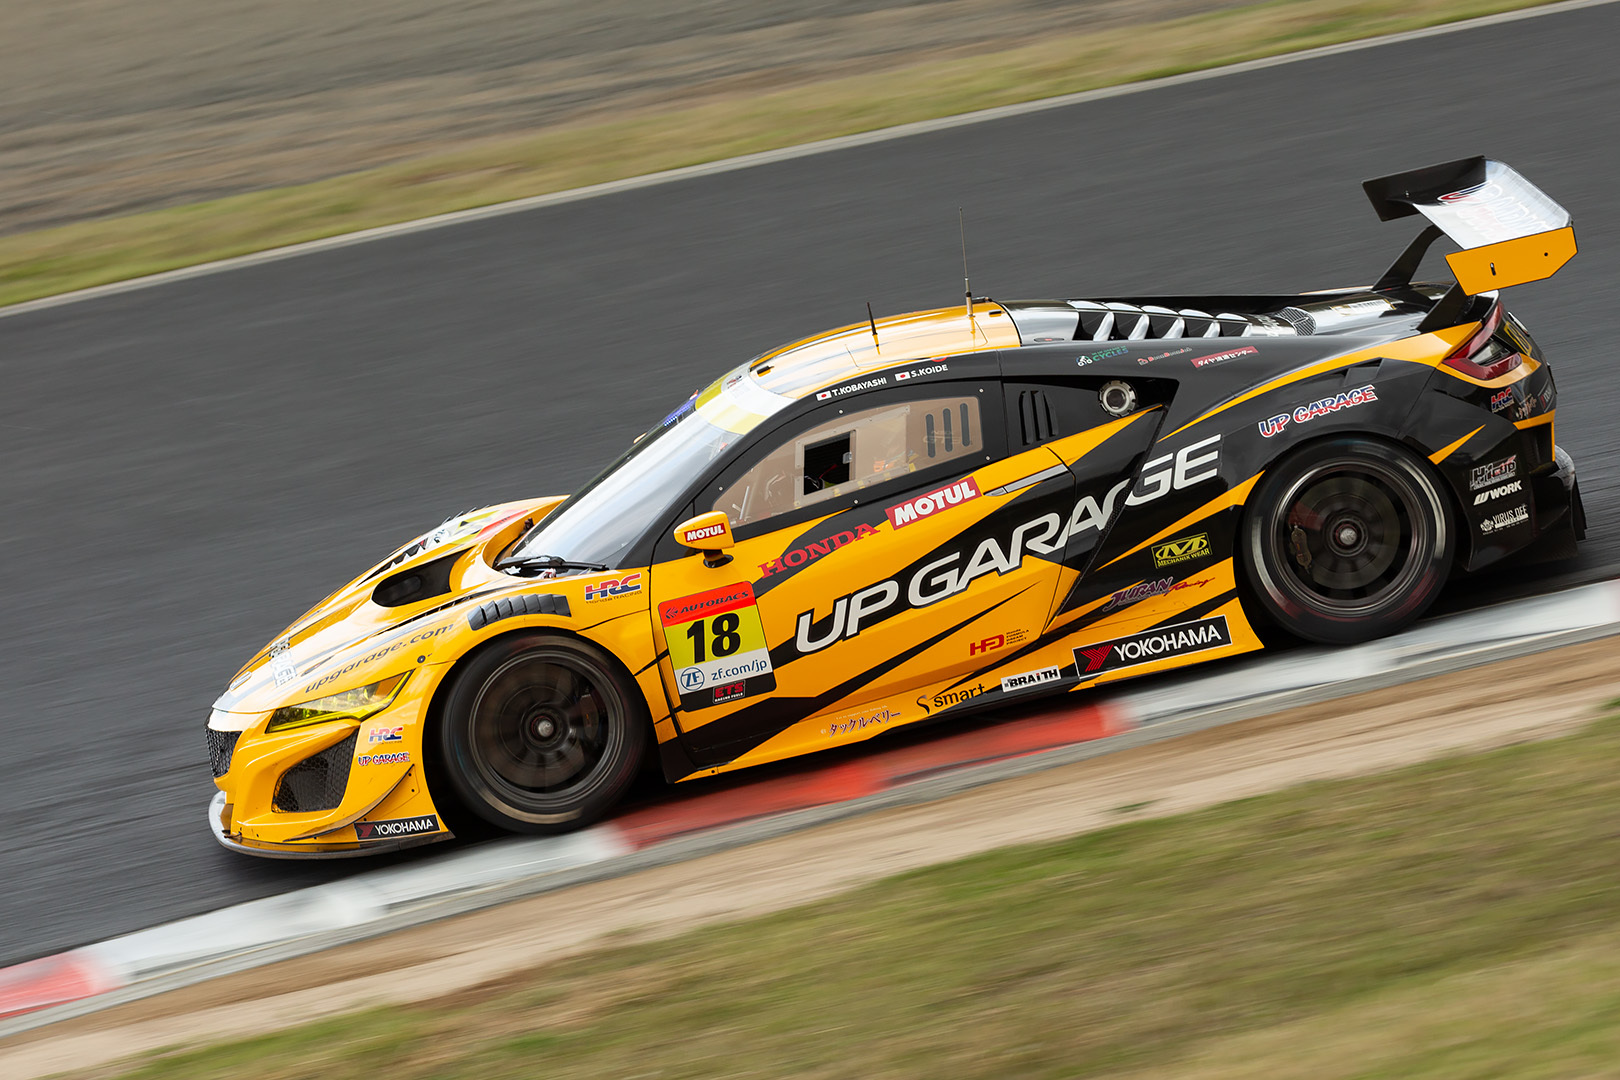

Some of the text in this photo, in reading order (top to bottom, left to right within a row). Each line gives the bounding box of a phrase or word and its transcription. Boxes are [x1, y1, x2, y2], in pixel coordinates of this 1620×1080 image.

[910, 364, 949, 378] S.KOIDE
[832, 377, 888, 397] T.KOBAYASHI
[1258, 384, 1379, 438] UP GARAGE
[1490, 480, 1522, 500] WORK
[895, 481, 977, 526] MOTUL
[686, 526, 724, 541] MOTUL
[796, 433, 1222, 654] UP GARAGE
[757, 523, 881, 579] HONDA
[585, 573, 641, 600] HRC
[1102, 576, 1174, 612] JURAN
[680, 591, 749, 614] AUTOBACS
[686, 612, 741, 664] 18
[1113, 624, 1222, 662] YOKOHAMA
[304, 624, 454, 693] upgarage.com
[711, 658, 768, 681] zf.com/jp
[714, 682, 743, 697] ETS
[933, 683, 985, 708] smart
[368, 726, 404, 742] HRC
[828, 709, 901, 738] タックルベリー
[358, 751, 410, 767] UP GARAGE
[374, 818, 434, 836] YOKOHAMA
